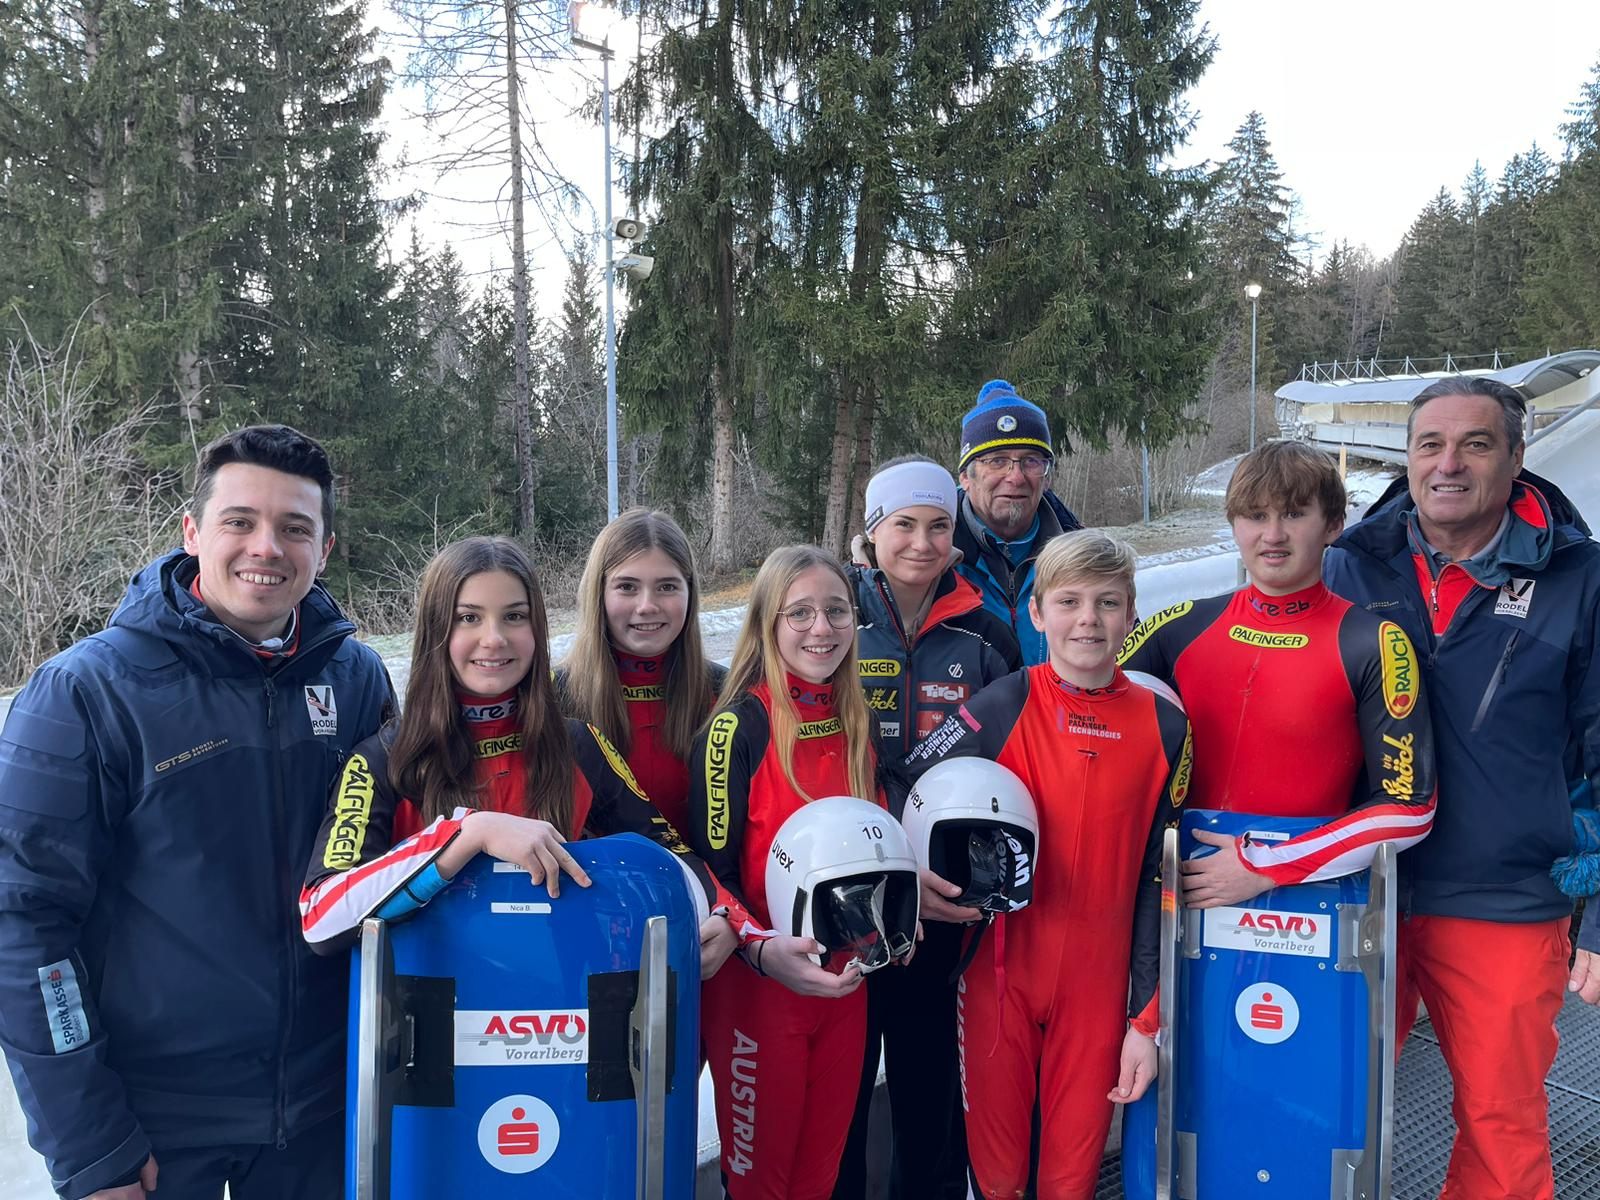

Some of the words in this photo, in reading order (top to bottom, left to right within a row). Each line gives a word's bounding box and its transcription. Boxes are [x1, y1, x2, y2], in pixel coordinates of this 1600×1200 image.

[1496, 602, 1527, 612] RODEL
[1232, 627, 1303, 646] PALFINGER
[1387, 630, 1411, 692] RAUCH
[312, 719, 337, 728] RODEL
[1068, 712, 1096, 722] HUBERT
[1068, 719, 1107, 731] PALFINGER
[797, 719, 840, 737] ALFINGER
[1068, 726, 1121, 739] TECHNOLOGIES
[920, 720, 960, 760] PALFINGER
[936, 726, 966, 758] HUBERT
[155, 751, 192, 772] GTS
[710, 717, 733, 841] PALFINGER
[862, 826, 883, 840] 10
[772, 839, 794, 873] uvex
[1254, 938, 1315, 954] Vorarlberg
[51, 981, 76, 1045] SPARKASSE
[505, 1047, 583, 1062] Vorarlberg
[728, 1028, 758, 1177] AUSTRIA
